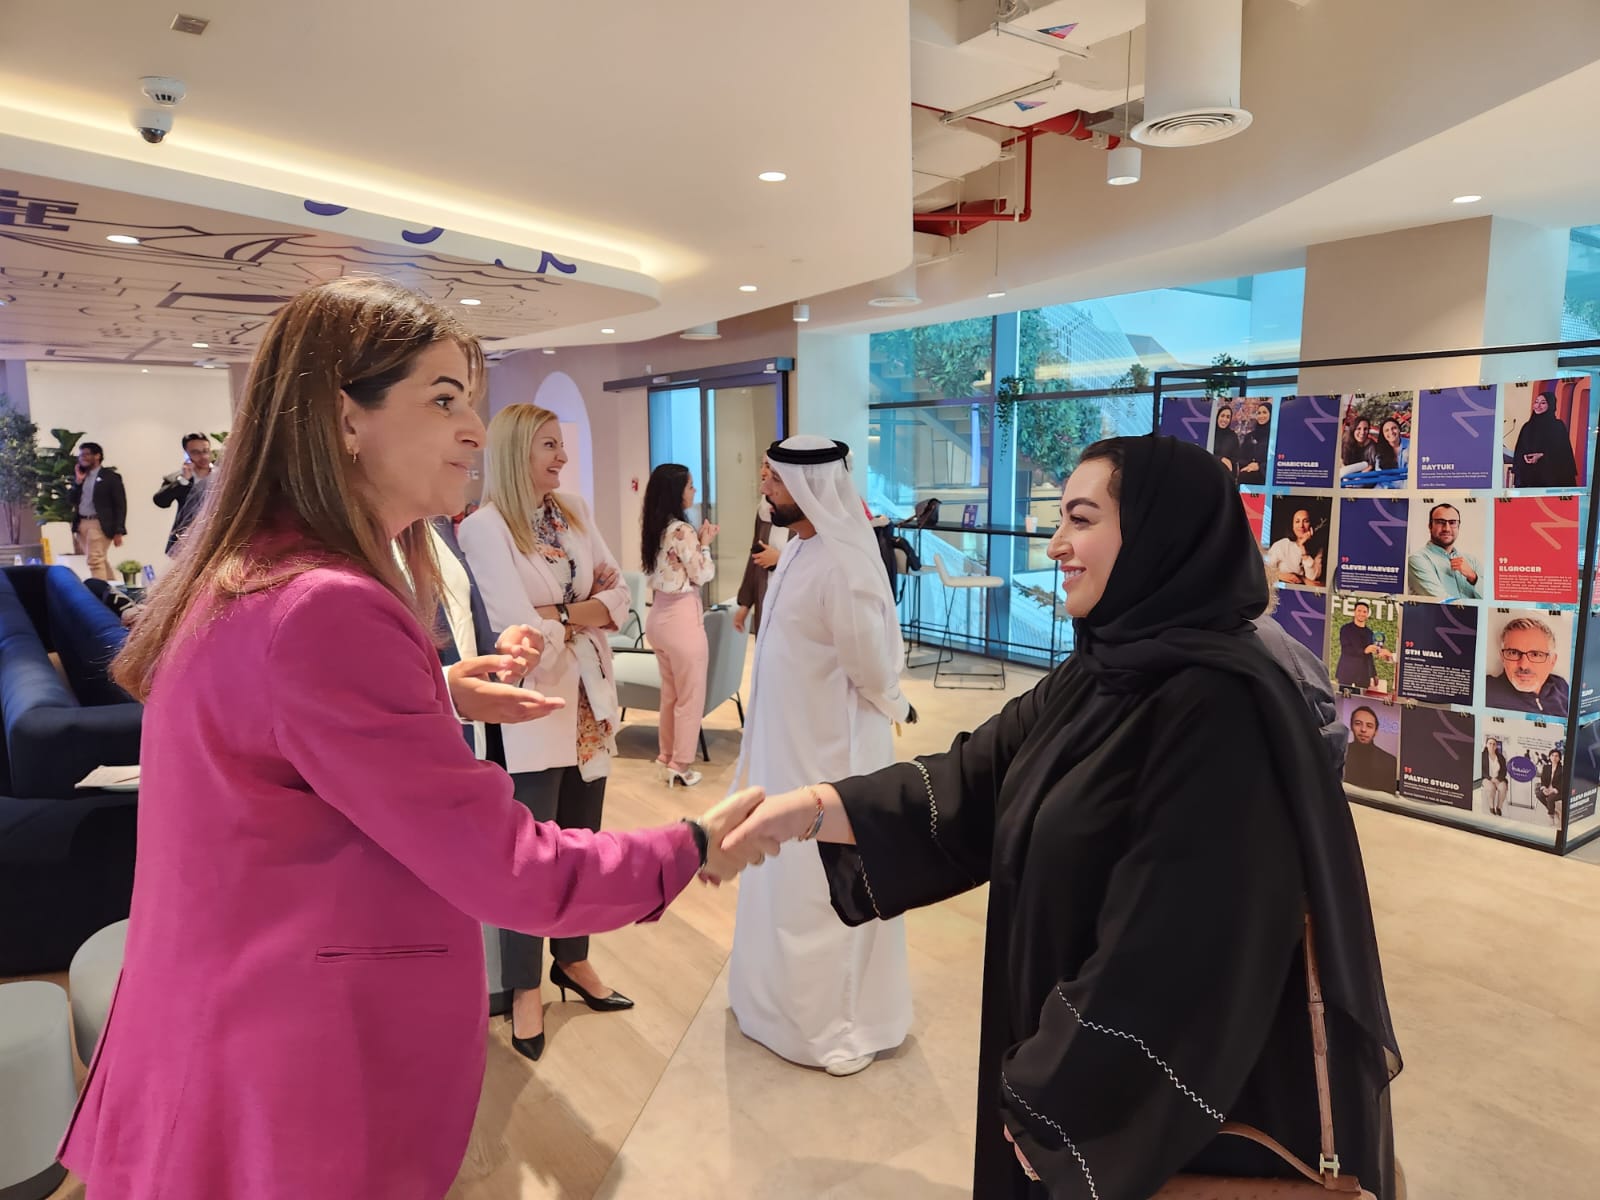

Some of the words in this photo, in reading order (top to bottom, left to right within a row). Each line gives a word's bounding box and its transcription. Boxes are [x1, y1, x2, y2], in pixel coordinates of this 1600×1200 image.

[1421, 463, 1455, 471] BAYTUKI
[1367, 565, 1399, 573] HARVEST
[1422, 650, 1443, 659] WALL
[1430, 778, 1460, 791] STUDIO
